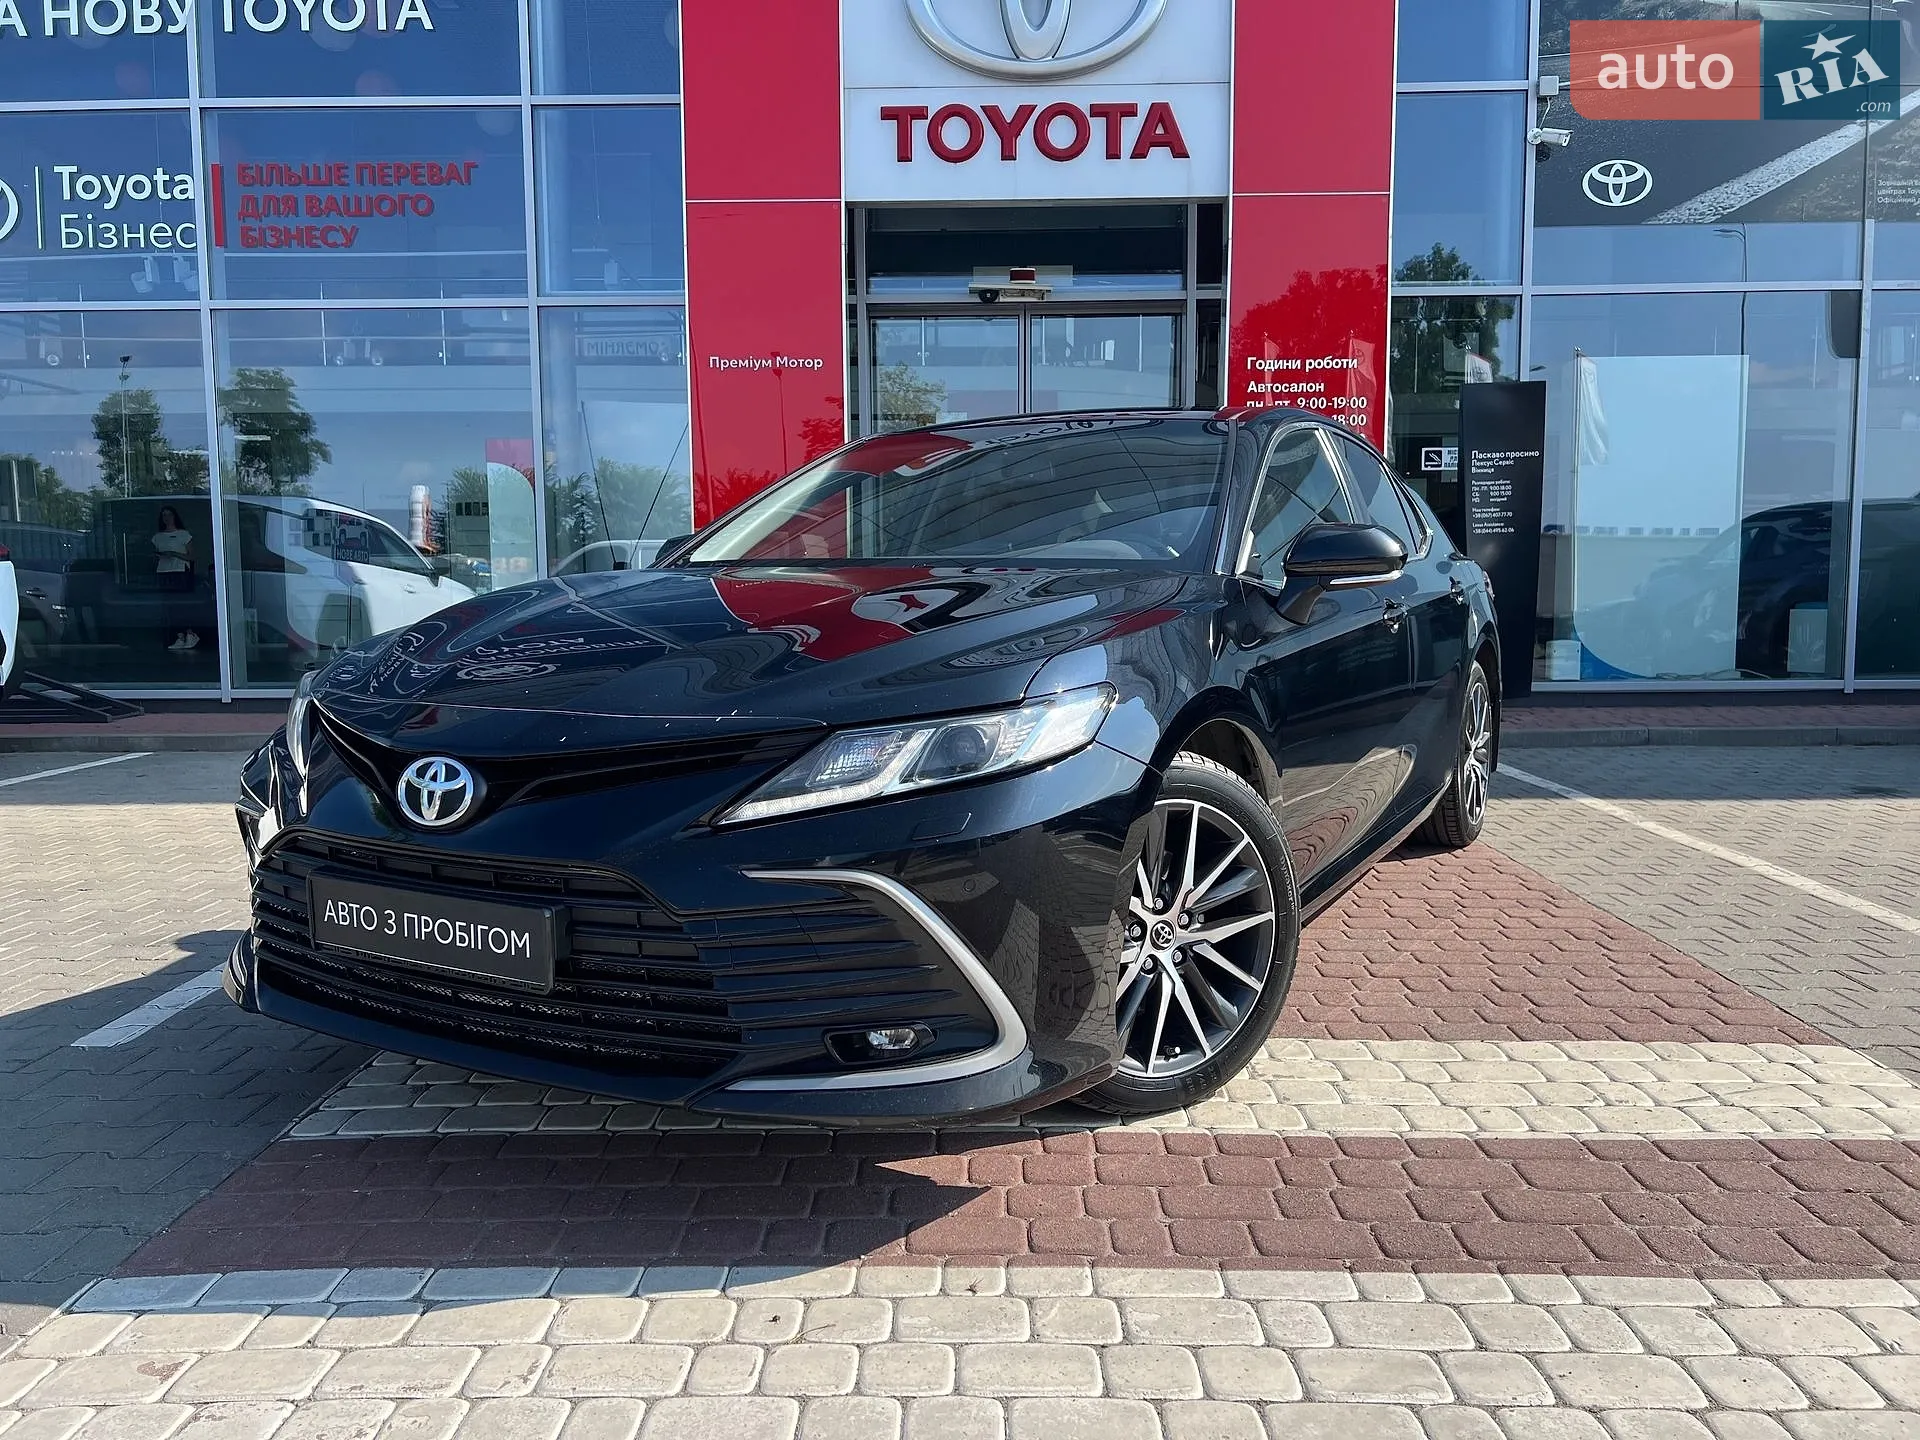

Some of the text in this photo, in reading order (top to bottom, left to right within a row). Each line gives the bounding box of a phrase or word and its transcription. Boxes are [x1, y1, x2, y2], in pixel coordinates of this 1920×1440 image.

[880, 102, 1191, 164] TOYOTA
[53, 165, 195, 209] Toyota
[237, 162, 479, 187] БІЛЬШЕ ПЕРЕВАГ
[237, 193, 435, 222] ДЛЯ ВАШОГО
[60, 213, 197, 249] Бізнес
[239, 224, 360, 249] БІЗНЕСУ
[709, 355, 823, 371] Преміум Мотор
[1246, 356, 1358, 373] Години роботи
[1247, 381, 1325, 393] Автосалон
[1297, 397, 1367, 409] 9:00-19:00
[1471, 450, 1540, 460] Ласкаво просимо
[324, 900, 530, 959] АВТО З ПРОБІГОМ
